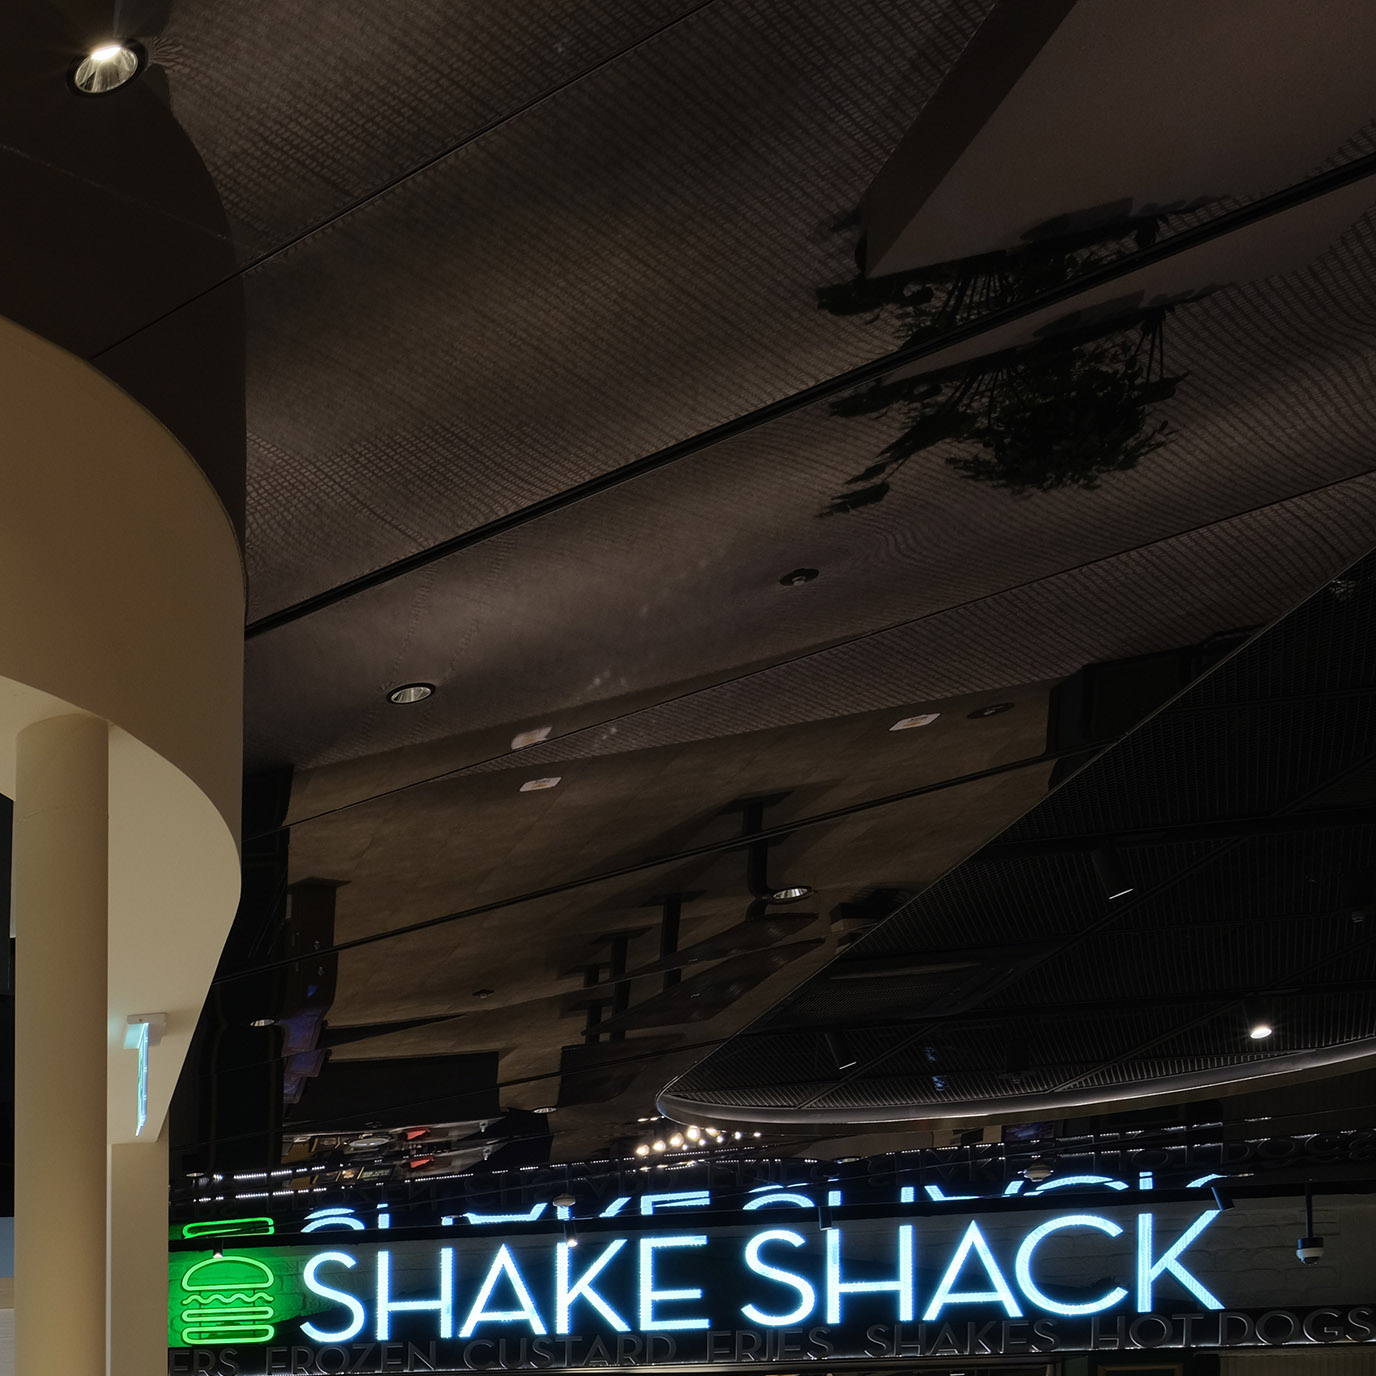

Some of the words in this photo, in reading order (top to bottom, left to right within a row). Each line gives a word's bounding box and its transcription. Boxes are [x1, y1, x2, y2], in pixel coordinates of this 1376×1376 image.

[298, 1234, 711, 1342] SHAKE
[739, 1208, 1225, 1326] SHACK
[461, 1333, 676, 1370] CUSTARD
[704, 1326, 836, 1363] FRIES
[863, 1319, 1060, 1358] SHAKES
[1090, 1313, 1206, 1351] HOT
[1217, 1306, 1376, 1347] DOGS
